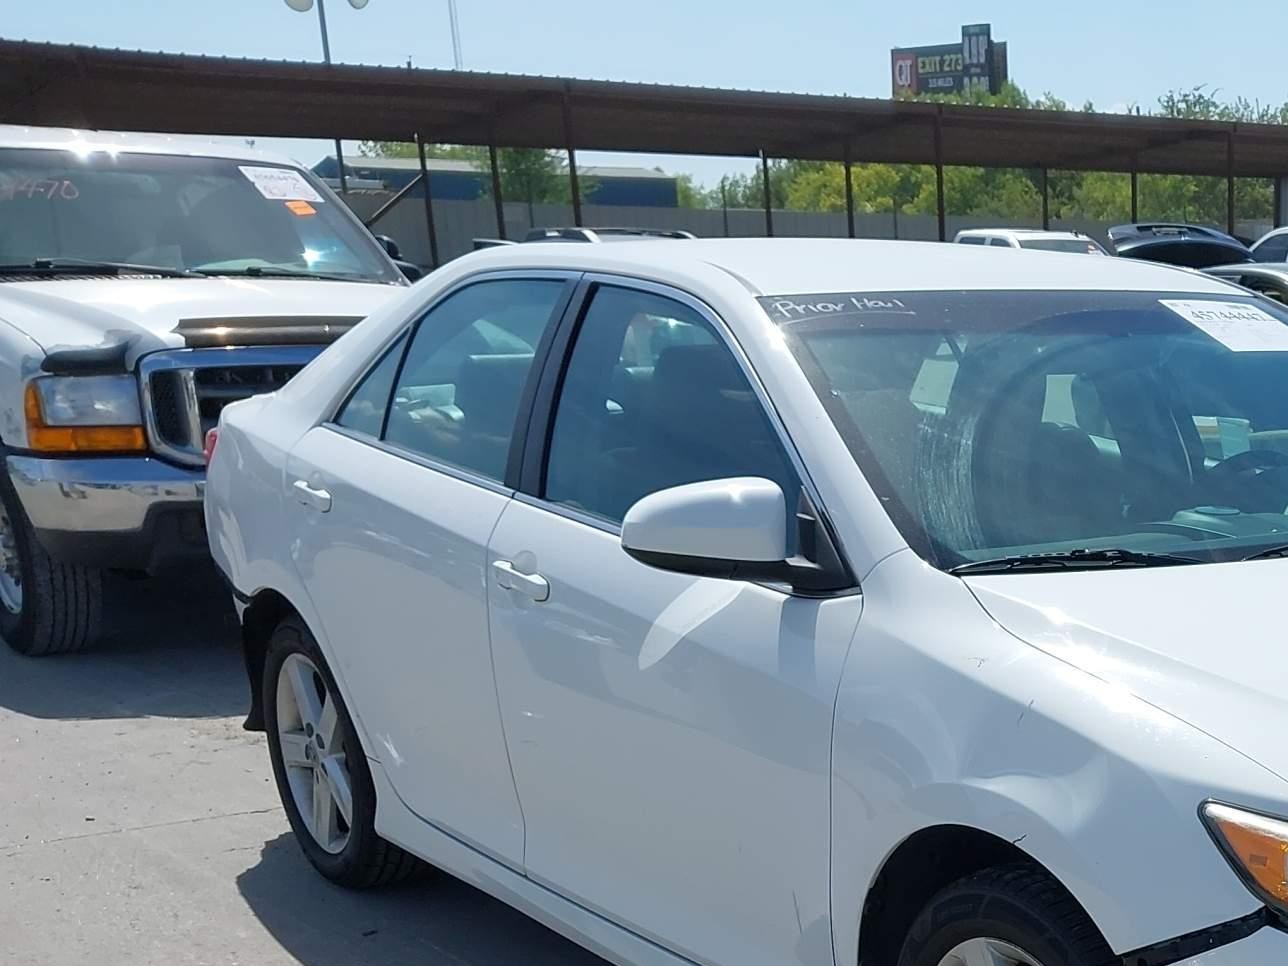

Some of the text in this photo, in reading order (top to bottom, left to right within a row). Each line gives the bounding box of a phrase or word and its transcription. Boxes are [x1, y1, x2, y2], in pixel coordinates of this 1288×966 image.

[895, 59, 912, 87] QT
[917, 54, 963, 74] EXIT 273
[771, 300, 845, 319] Prior
